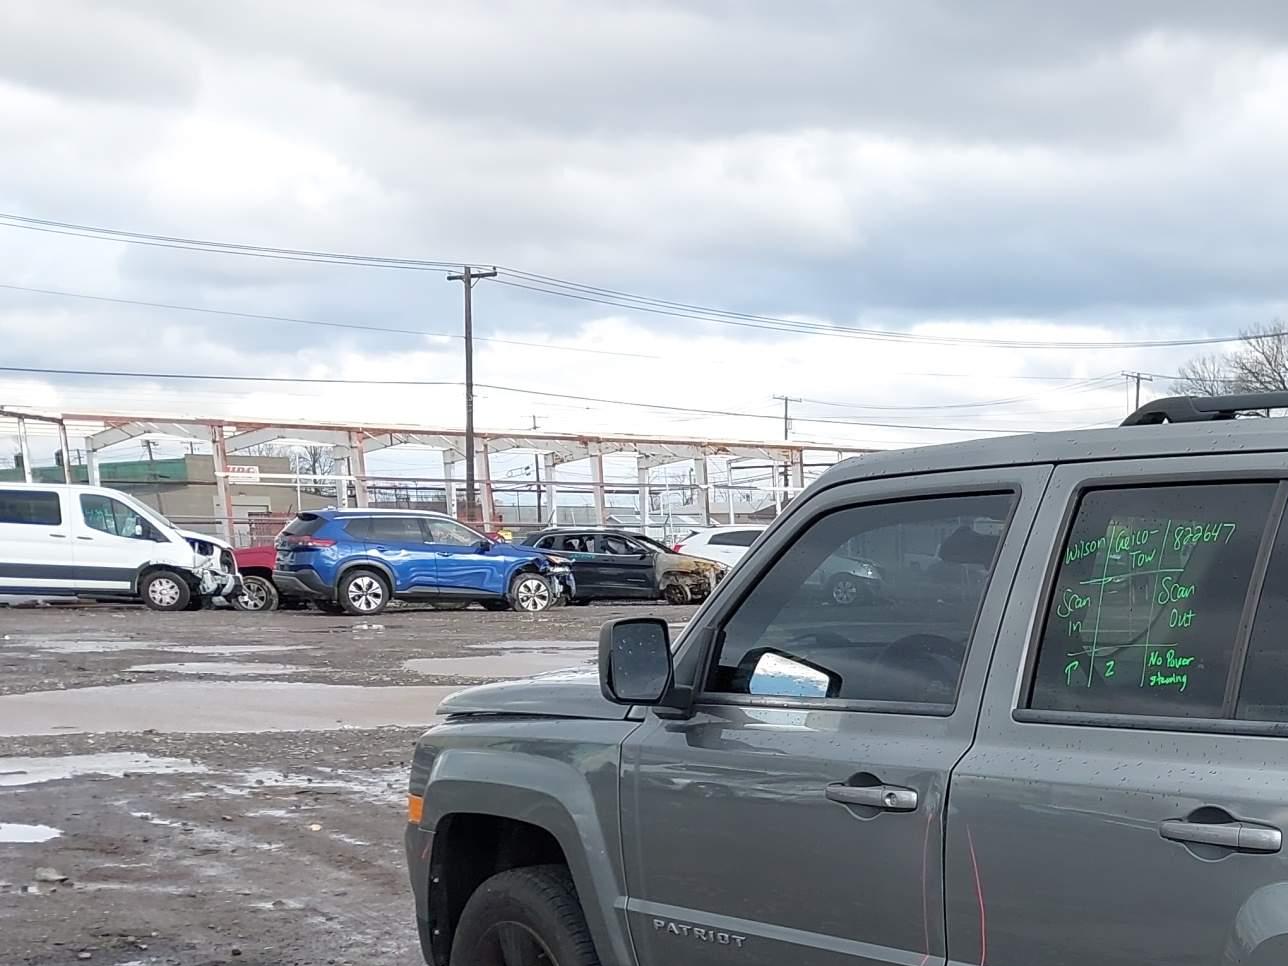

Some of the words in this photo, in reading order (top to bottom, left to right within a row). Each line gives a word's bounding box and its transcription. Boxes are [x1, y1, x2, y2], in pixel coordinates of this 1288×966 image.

[1065, 537, 1107, 565] Wilson
[1173, 523, 1236, 551] 822647
[1130, 549, 1156, 569] Tow
[1057, 588, 1091, 618] Scan
[1158, 576, 1194, 605] Scan
[1169, 608, 1196, 628] Out
[1149, 652, 1163, 667] No
[653, 919, 746, 948] PATRIOT
